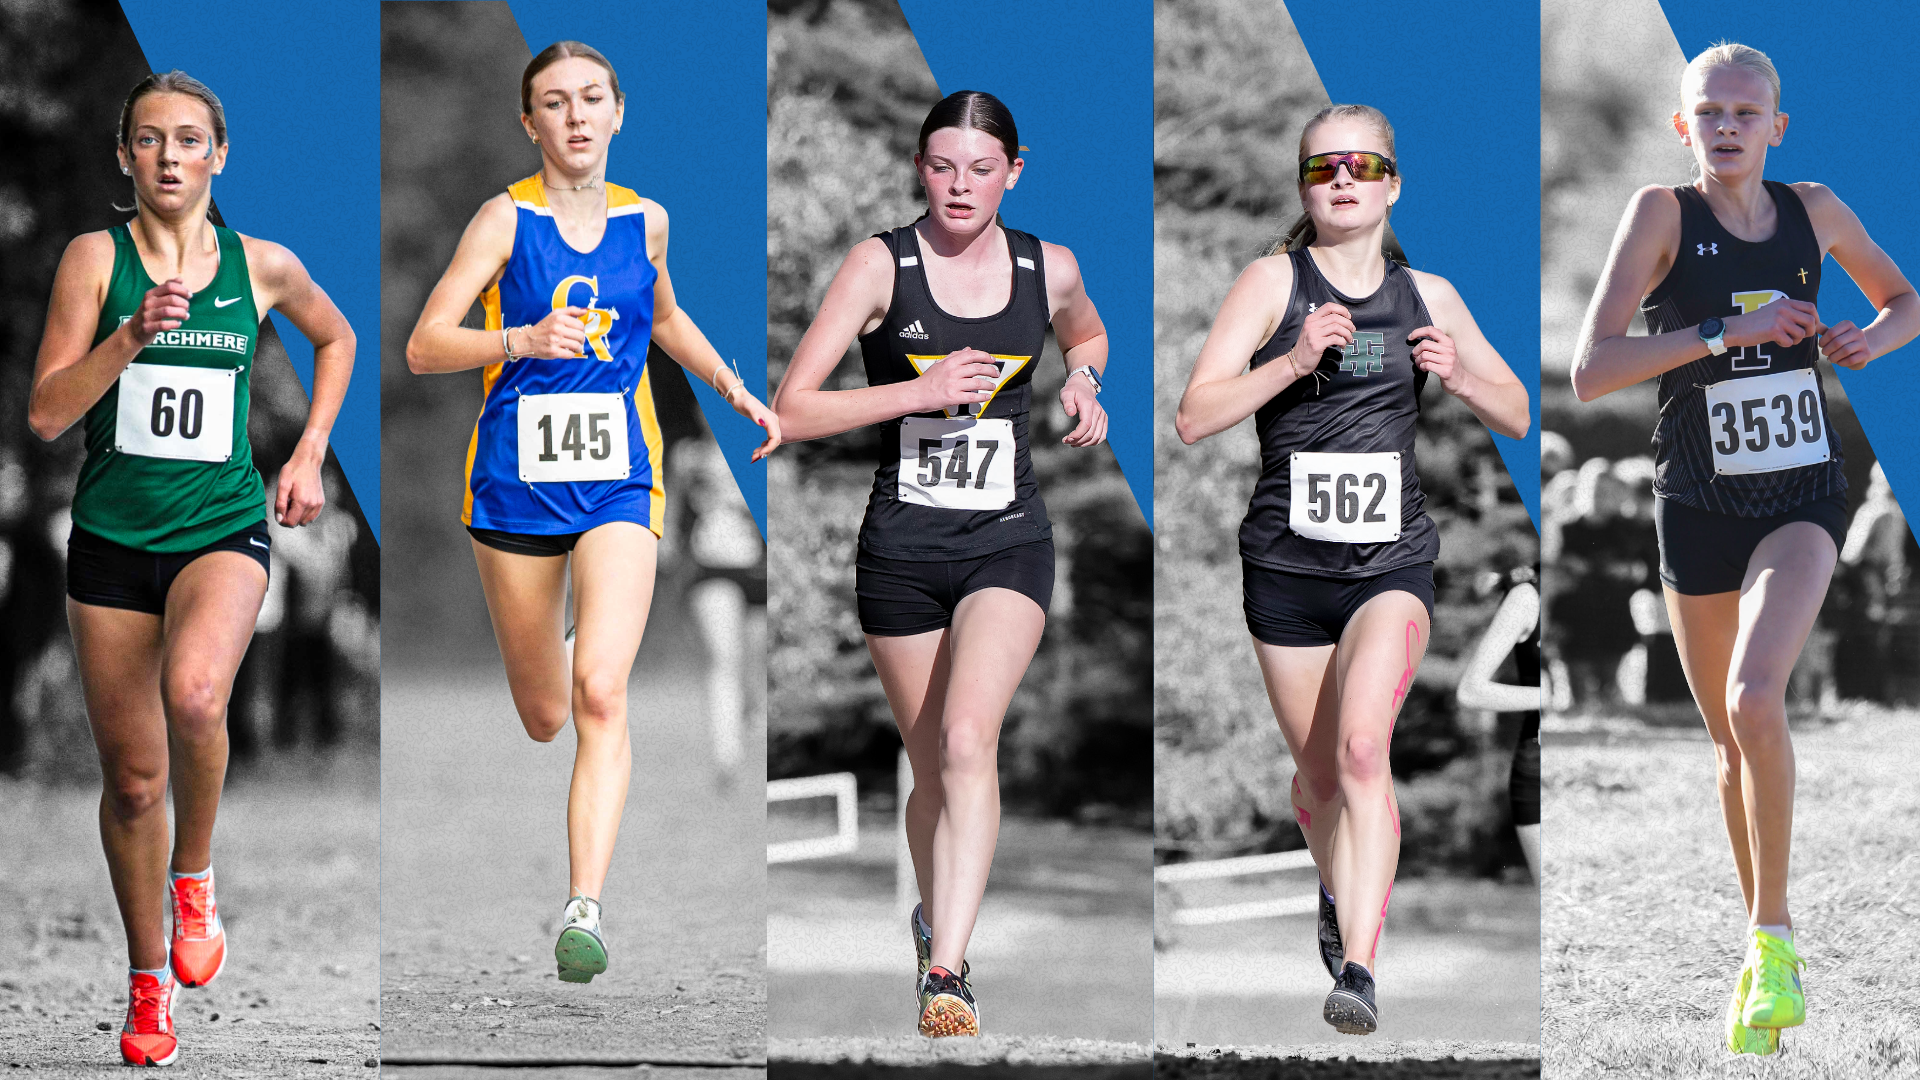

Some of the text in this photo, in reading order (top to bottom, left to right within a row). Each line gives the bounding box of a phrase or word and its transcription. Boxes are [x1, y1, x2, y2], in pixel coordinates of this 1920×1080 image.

[899, 330, 929, 340] adidas
[151, 386, 204, 440] 60
[537, 412, 611, 462] 145
[1711, 389, 1822, 456] 3539
[917, 437, 999, 490] 547
[1307, 472, 1387, 524] 562
